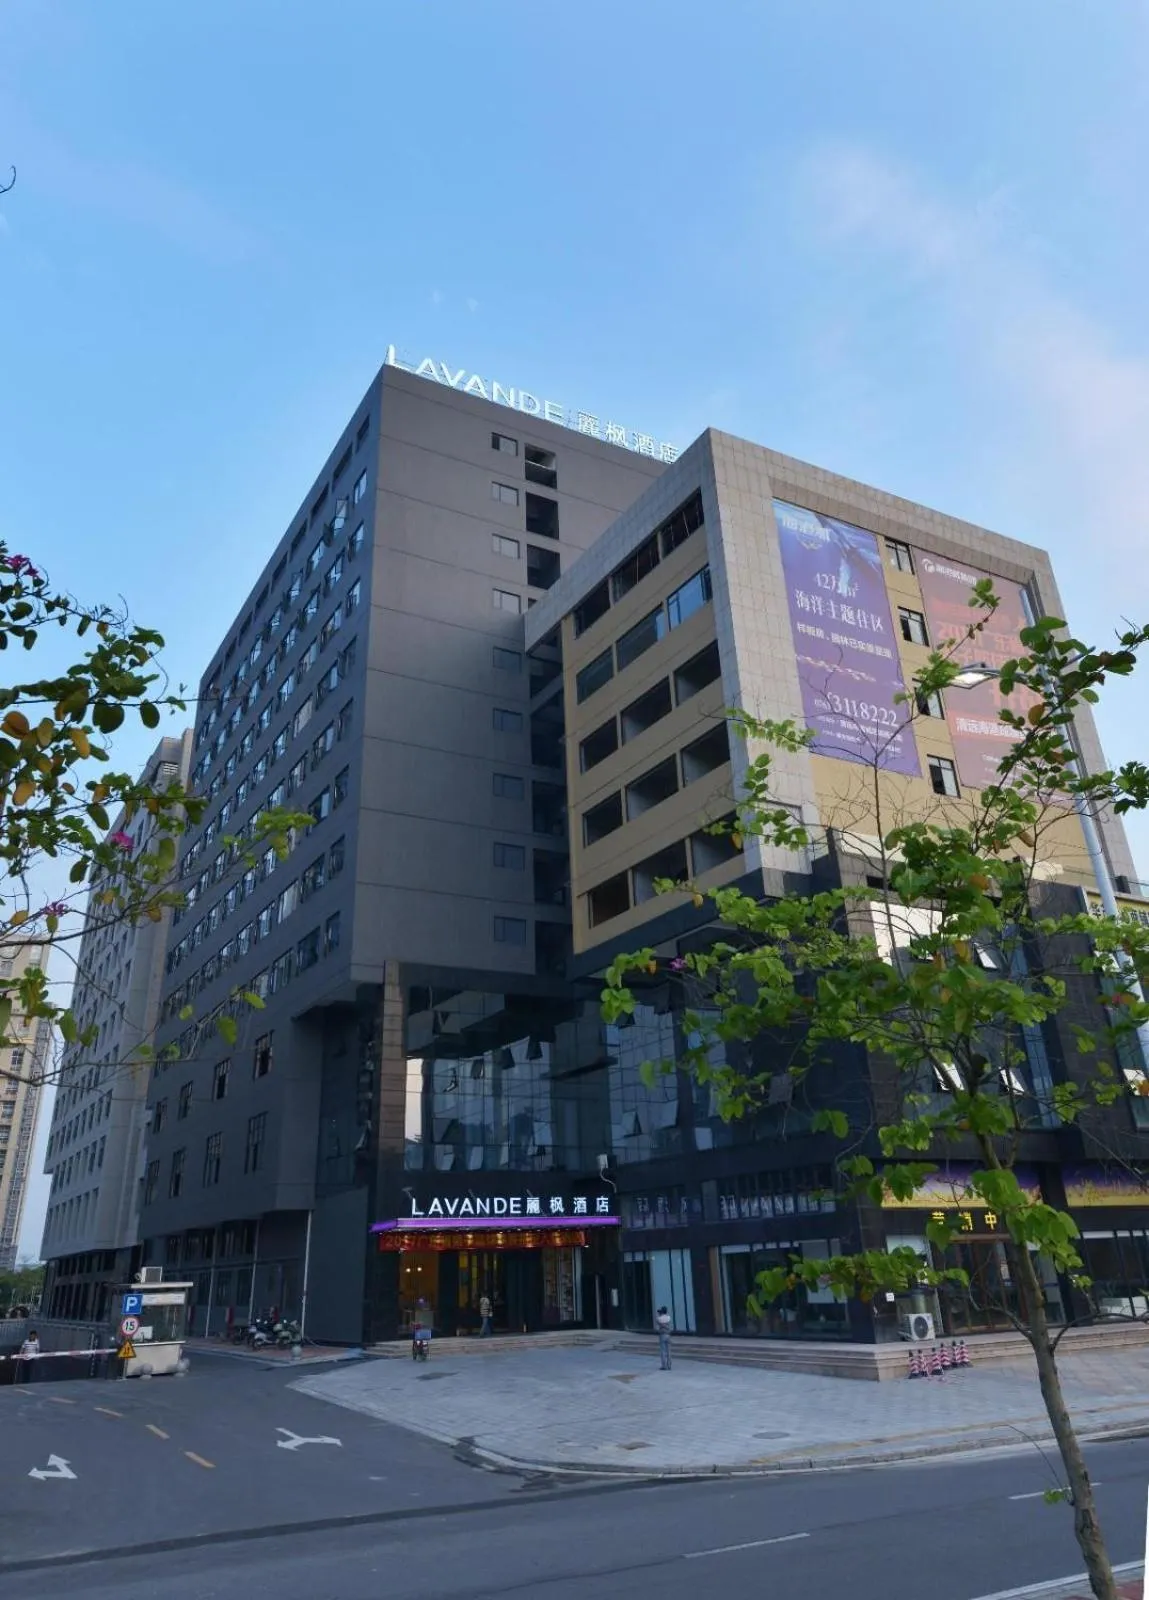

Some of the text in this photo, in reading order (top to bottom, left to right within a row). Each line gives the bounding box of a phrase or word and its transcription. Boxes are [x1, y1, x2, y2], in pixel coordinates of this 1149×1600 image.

[385, 344, 565, 427] LAVANDE
[832, 694, 899, 727] 3118222
[411, 1197, 522, 1216] LAVANDE
[125, 1296, 138, 1313] P
[125, 1320, 135, 1331] 15
